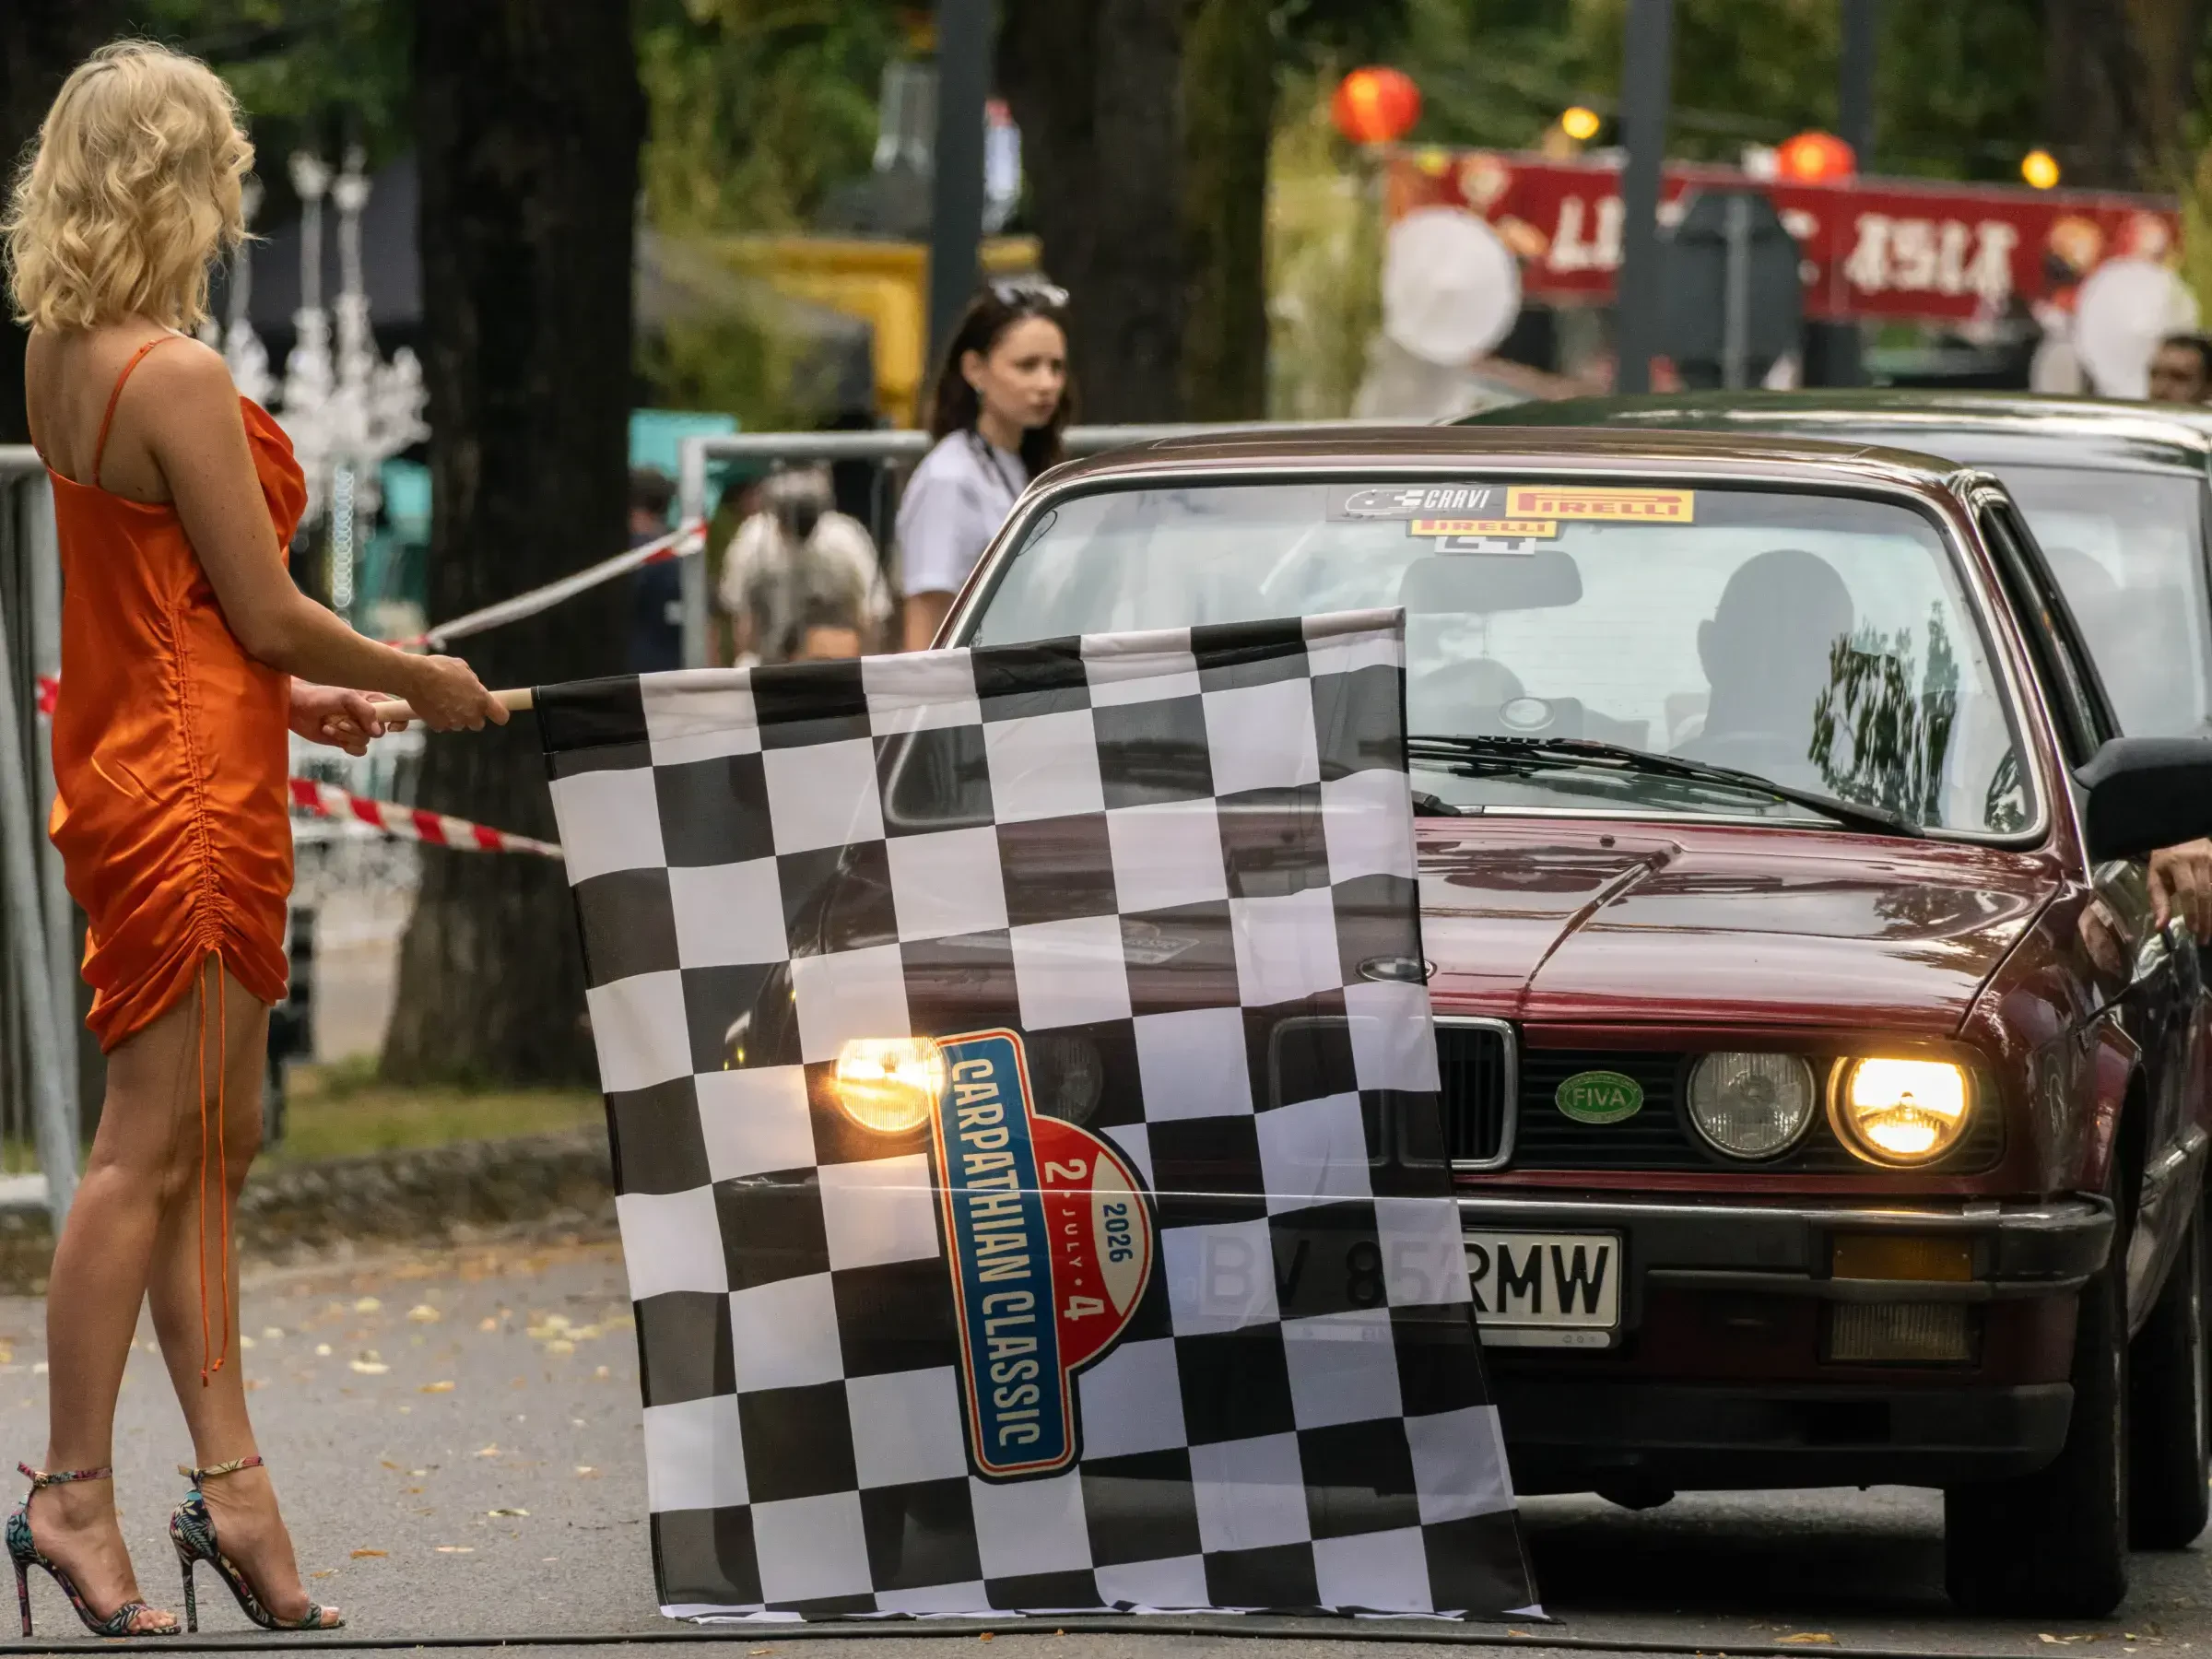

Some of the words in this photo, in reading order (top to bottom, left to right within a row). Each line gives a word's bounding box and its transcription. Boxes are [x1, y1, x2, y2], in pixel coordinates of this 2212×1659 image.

[1517, 492, 1683, 516] PIRELLI
[1572, 1088, 1627, 1107] FIVA
[952, 1058, 1032, 1282] CARPATHIAN
[1102, 1203, 1134, 1264] 2026
[1206, 1236, 1311, 1307] BV
[982, 1290, 1041, 1447] CLASSIC
